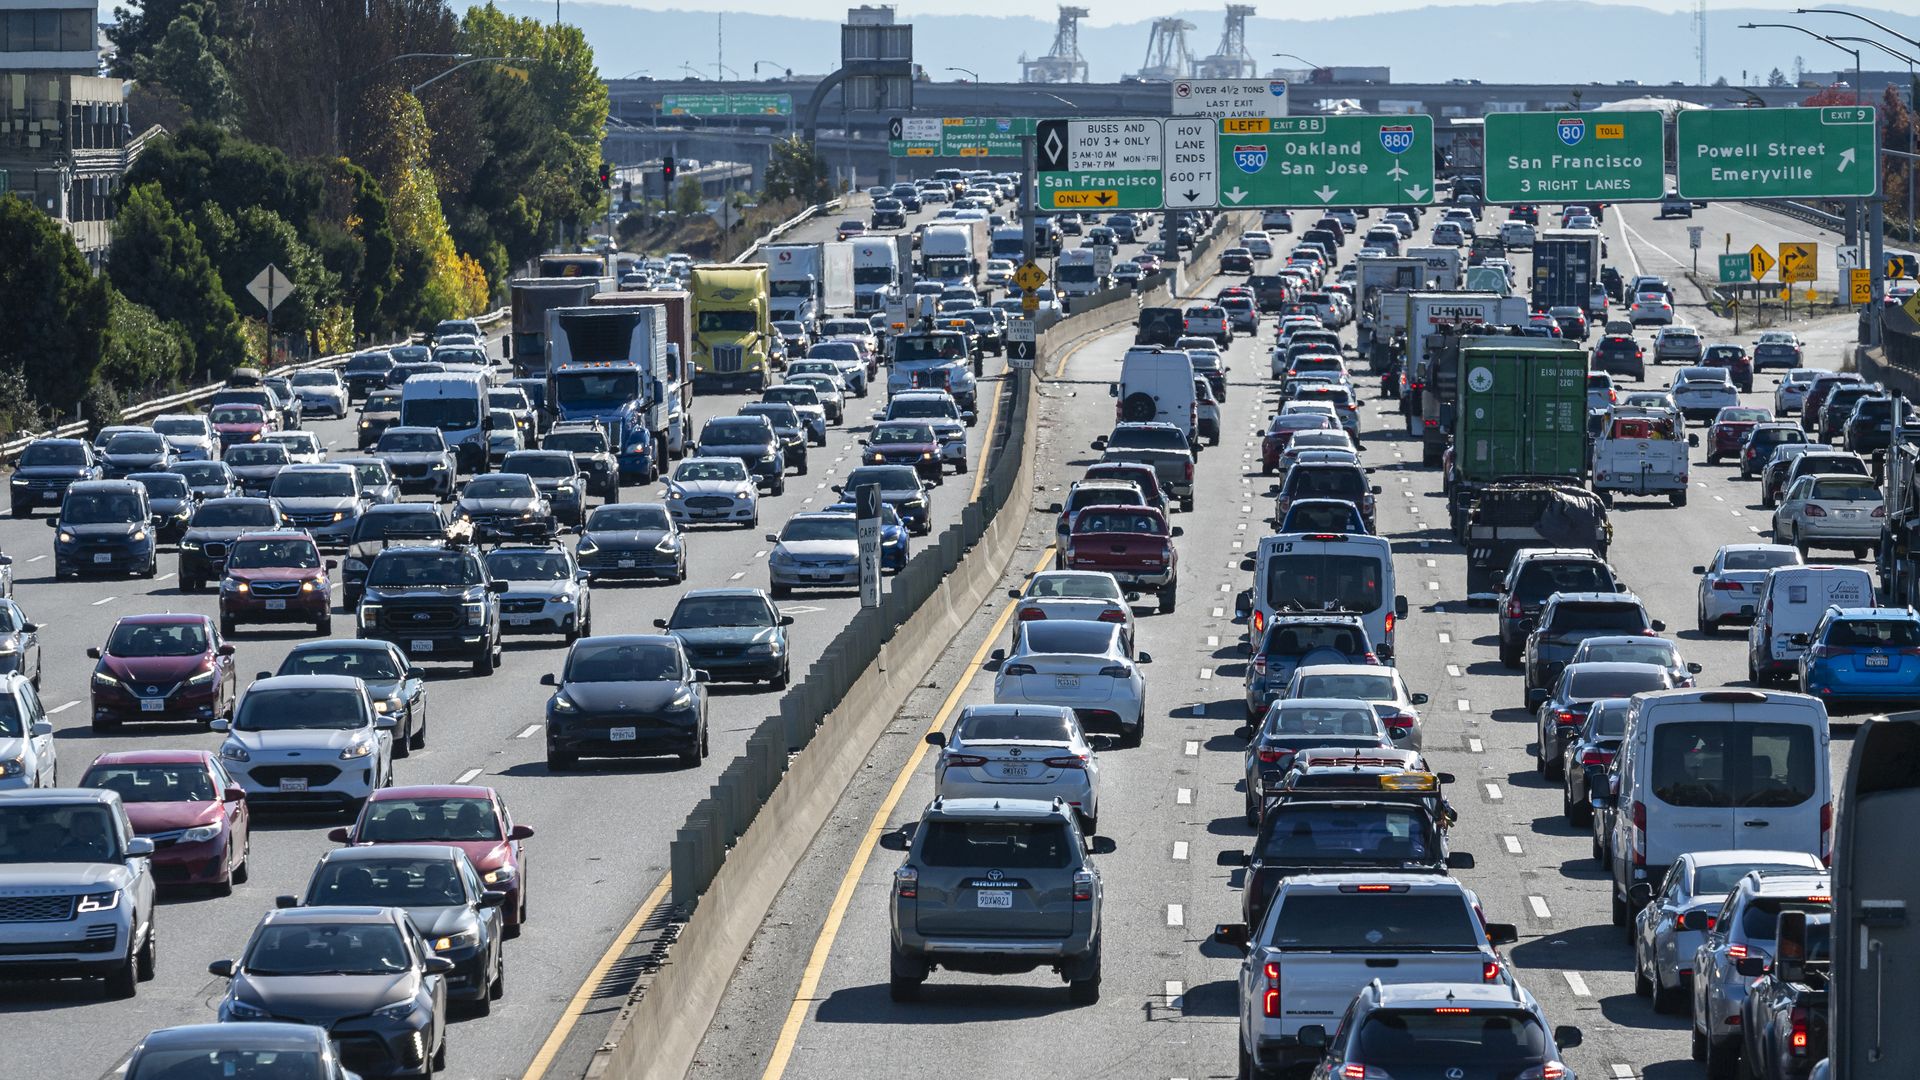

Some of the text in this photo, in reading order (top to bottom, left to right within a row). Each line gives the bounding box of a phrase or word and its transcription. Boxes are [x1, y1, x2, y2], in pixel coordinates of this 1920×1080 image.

[1194, 86, 1217, 94] OVER
[1242, 86, 1265, 94] TONS
[1831, 110, 1866, 121] EXIT 9
[1087, 124, 1145, 133] BUSES AND
[1229, 120, 1264, 131] LEFT
[1273, 121, 1294, 129] EXIT
[1177, 127, 1202, 135] HOV
[1562, 126, 1581, 140] 80
[1599, 127, 1620, 136] TOLL
[1079, 137, 1100, 146] HOV
[1124, 136, 1150, 146] ONLY
[1175, 140, 1205, 149] LANE
[1384, 134, 1411, 147] 880
[1285, 141, 1361, 155] Oakland
[1697, 142, 1826, 158] Powell Street
[1175, 154, 1206, 163] ENDS
[1238, 154, 1265, 167] 580
[1508, 154, 1643, 169] San Francisco
[1281, 160, 1369, 175] San Jose
[1170, 172, 1212, 182] 600 FT
[1711, 166, 1813, 184] Emeryville
[1044, 174, 1157, 187] San Francisco
[1520, 179, 1631, 192] 3 RIGHT LANES
[1058, 194, 1089, 204] ONLY
[1724, 257, 1745, 267] EXIT
[1729, 271, 1736, 279] 9
[1855, 284, 1870, 294] 20
[1431, 306, 1482, 316] U-HAUL
[1271, 542, 1293, 554] 103
